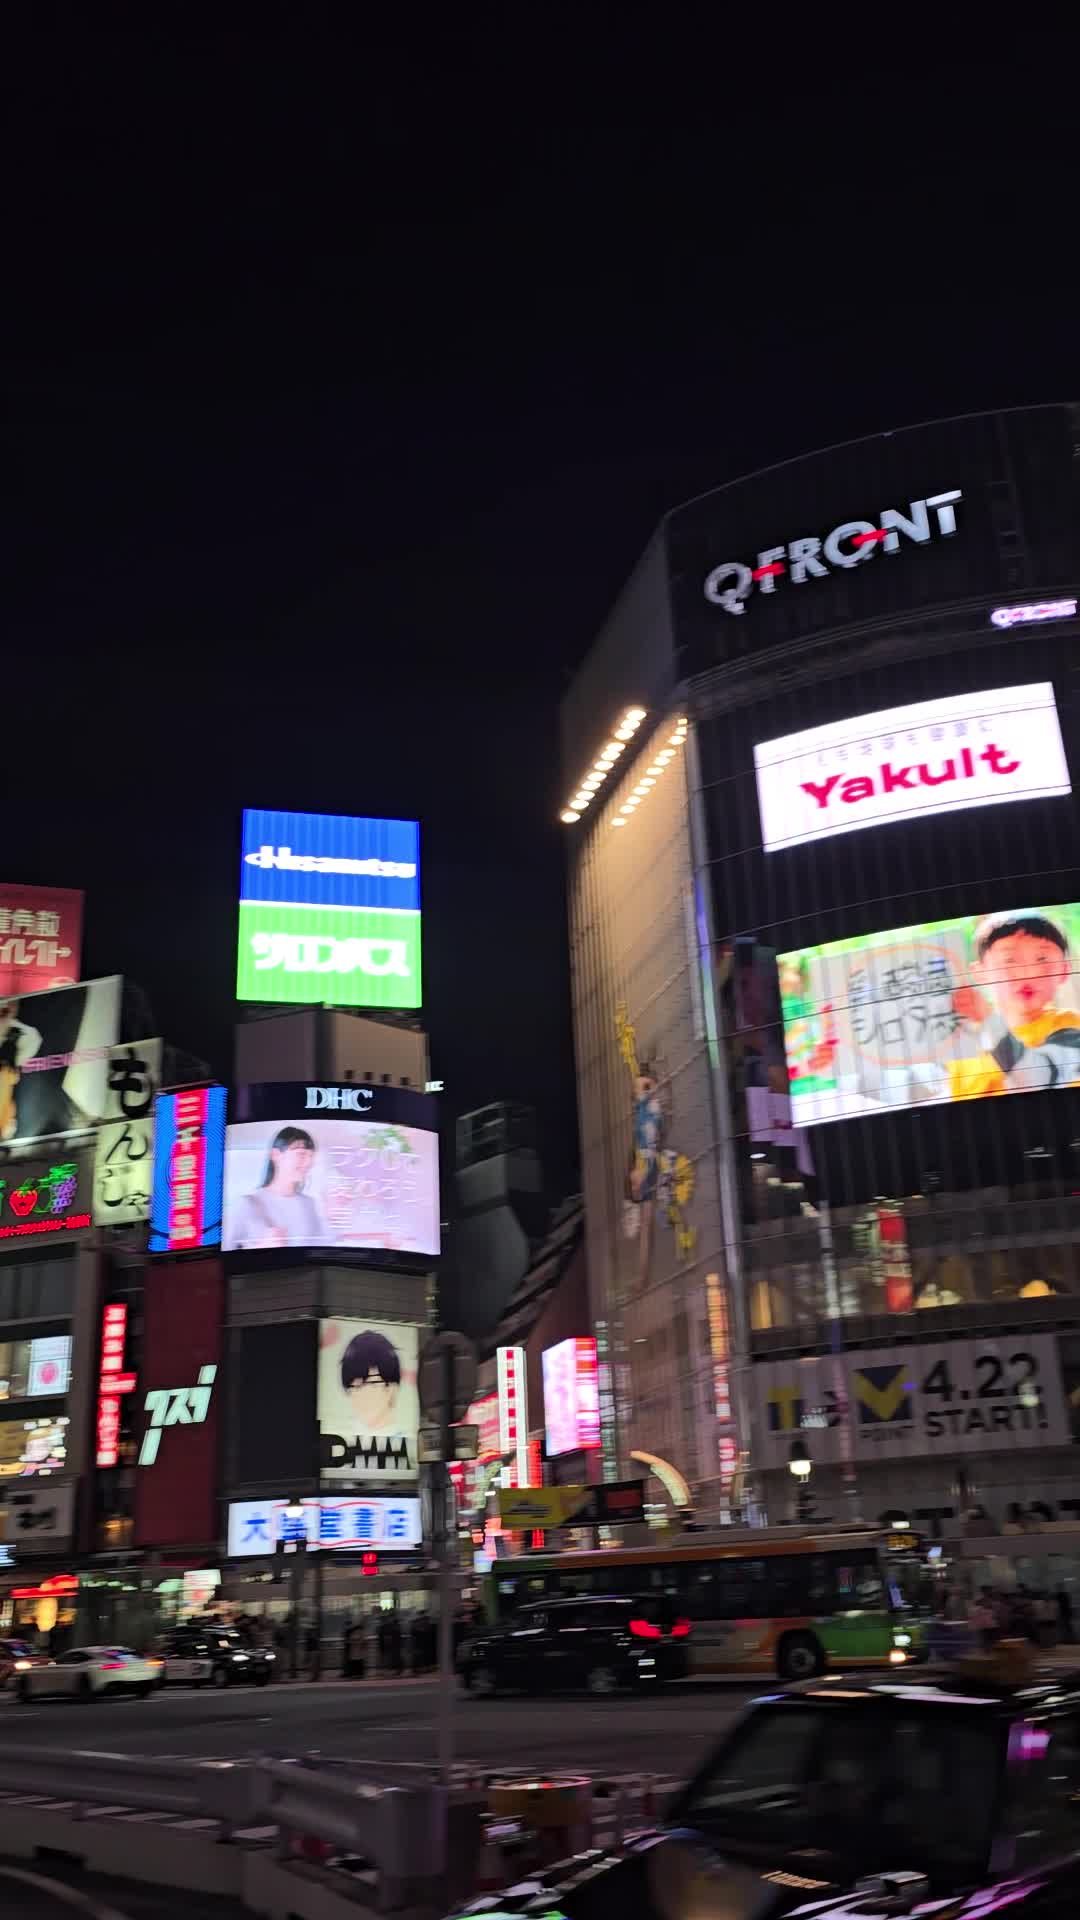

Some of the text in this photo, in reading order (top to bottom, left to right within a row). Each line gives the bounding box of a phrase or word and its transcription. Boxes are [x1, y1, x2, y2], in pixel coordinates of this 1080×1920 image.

[704, 489, 963, 615] QFRONT
[800, 743, 1022, 808] Yakult
[305, 1087, 373, 1111] DHC
[922, 1352, 1041, 1401] 4.22
[924, 1404, 1049, 1437] START!
